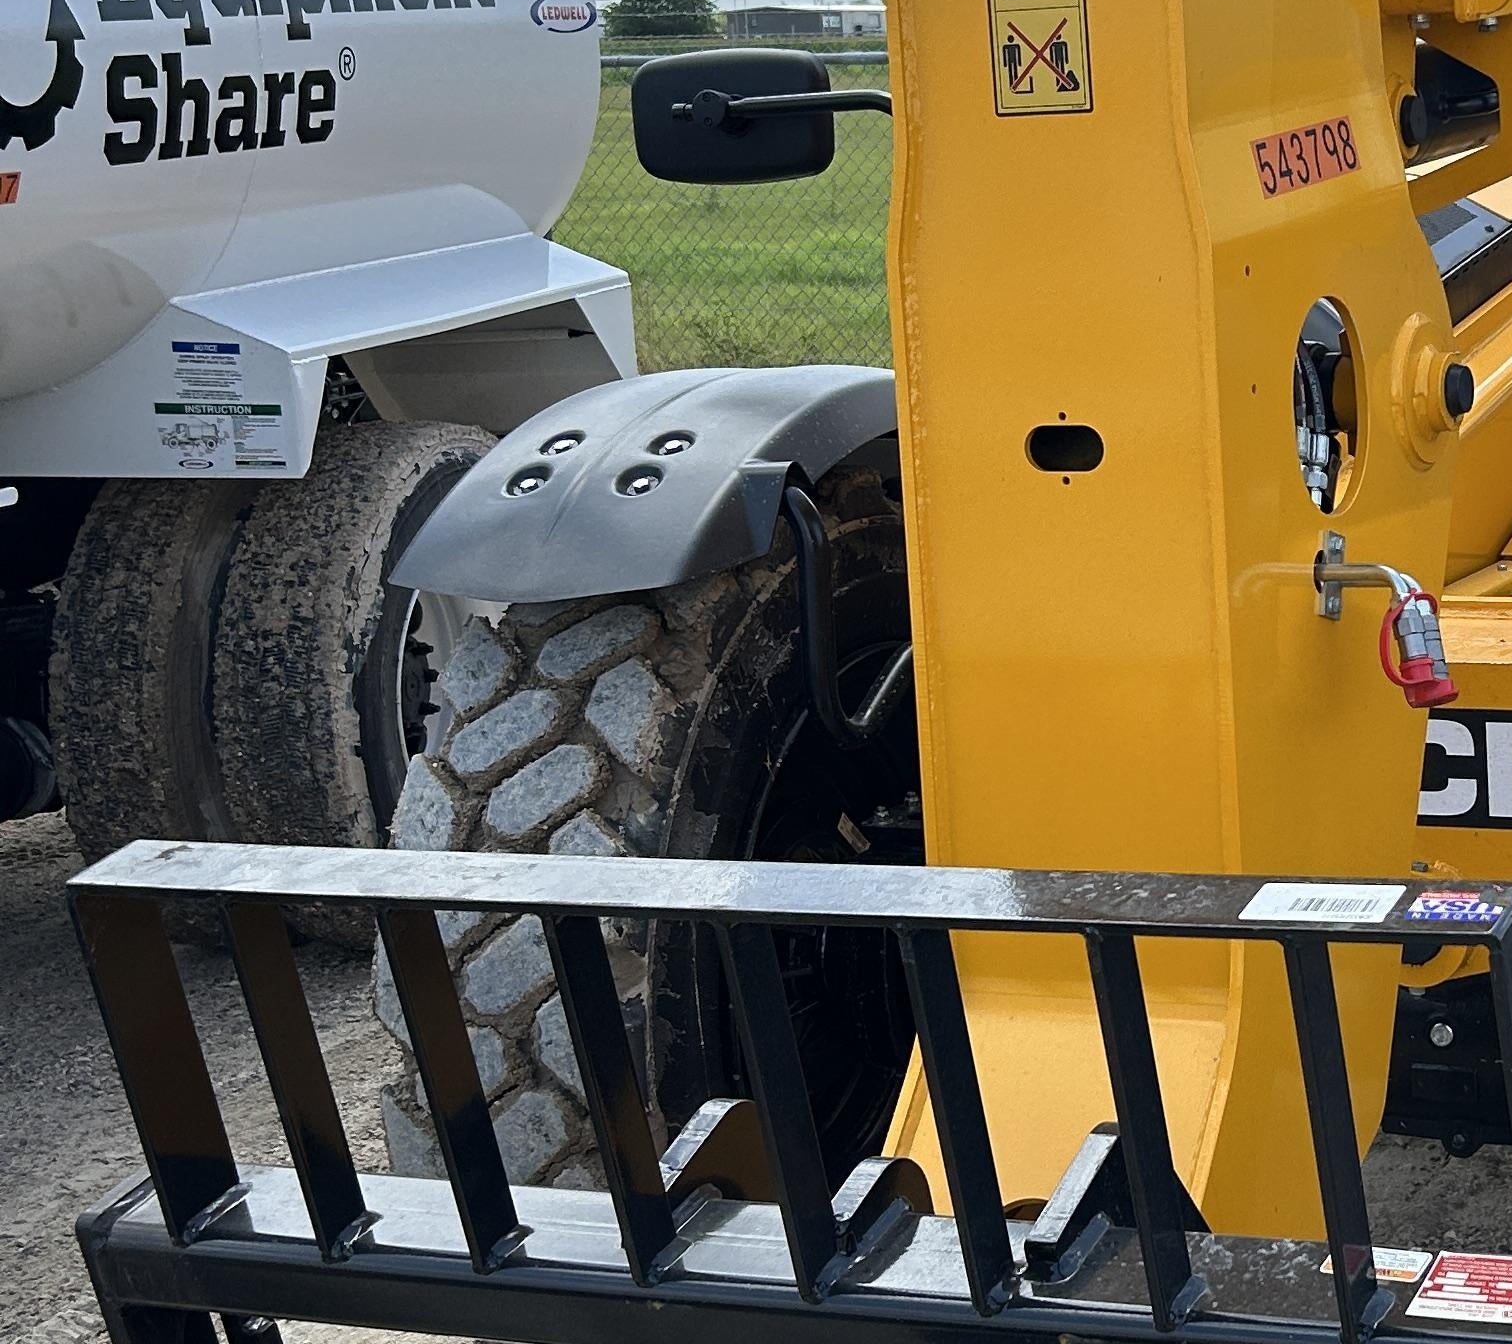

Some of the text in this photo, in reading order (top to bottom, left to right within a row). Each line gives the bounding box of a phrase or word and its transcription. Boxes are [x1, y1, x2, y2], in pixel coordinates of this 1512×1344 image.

[541, 6, 588, 21] LEDWELL
[1255, 119, 1357, 194] 543798
[184, 405, 252, 415] INSTRUCTION
